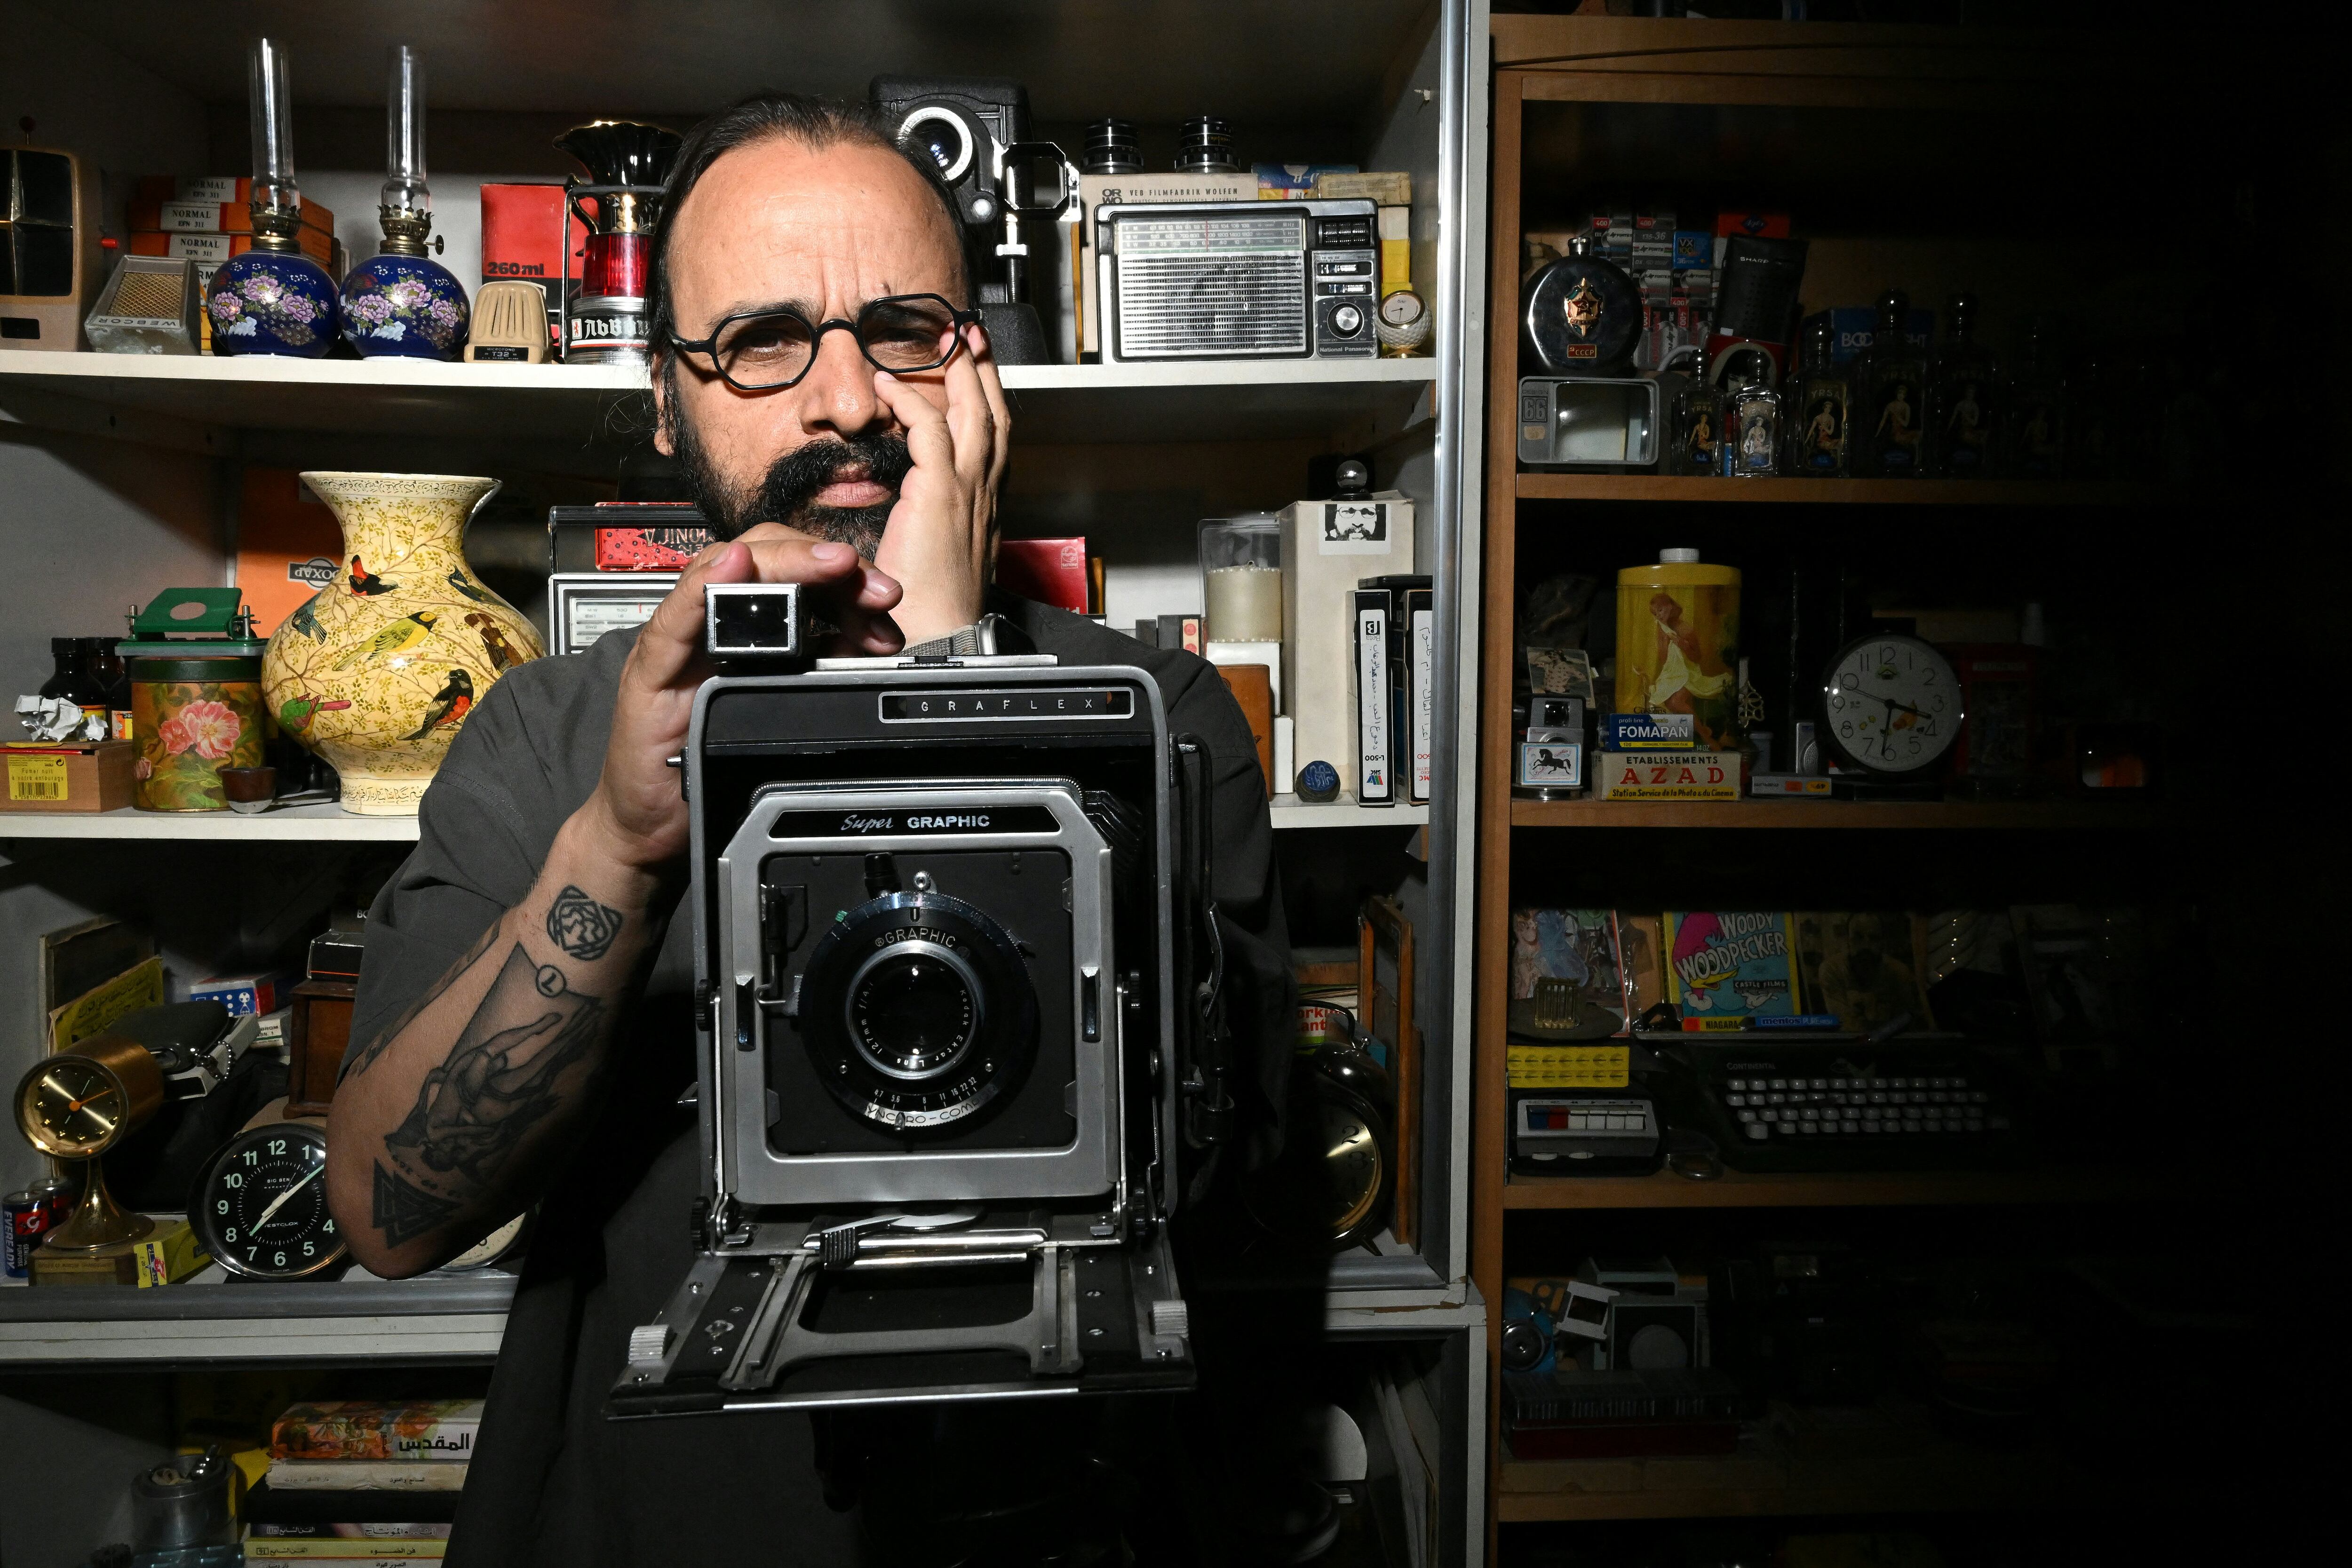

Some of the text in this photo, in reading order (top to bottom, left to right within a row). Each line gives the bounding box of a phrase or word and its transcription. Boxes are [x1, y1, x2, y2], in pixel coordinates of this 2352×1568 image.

[173, 210, 211, 218] NORMAL
[181, 239, 219, 248] NORMAL
[1679, 239, 1693, 247] VX
[1860, 653, 1869, 672] 11
[1880, 646, 1896, 665] 12
[1839, 673, 1859, 691] 10
[1922, 668, 1936, 685] 2
[921, 699, 1094, 712] GRAFLEX
[1832, 696, 1845, 713] 9
[1931, 694, 1945, 712] 3
[1619, 726, 1688, 738] FOMAPAN
[1841, 721, 1853, 739] 8
[1925, 719, 1937, 736] 4
[1863, 737, 1874, 756] 7
[1883, 744, 1896, 762] 6
[1908, 736, 1921, 754] 5
[1620, 767, 1724, 784] AZAD
[841, 814, 990, 833] Super GRAPHIC
[1718, 912, 1774, 940] WOODY
[1676, 931, 1788, 984] WOODPECKER
[960, 989, 969, 1026] Kodak
[1706, 1021, 1739, 1029] NIAGARA
[861, 1019, 882, 1054] 127mm
[935, 1035, 963, 1061] Ektar
[1726, 1062, 1776, 1070] CONTINENTAL
[960, 1082, 969, 1091] 22
[968, 1076, 977, 1086] 32
[874, 1089, 884, 1097] 4.7
[891, 1094, 900, 1103] 5.6
[951, 1088, 959, 1096] 16
[1342, 1126, 1360, 1144] 2
[268, 1140, 286, 1155] 12
[302, 1145, 310, 1160] 1
[243, 1151, 257, 1165] 11
[1348, 1151, 1368, 1170] 3
[223, 1173, 242, 1188] 10
[217, 1200, 229, 1215] 9
[226, 1227, 237, 1242] 8
[323, 1219, 335, 1234] 4
[4, 1210, 15, 1269] EVEREADY
[247, 1247, 257, 1261] 7
[303, 1242, 315, 1256] 5
[274, 1251, 286, 1266] 6
[399, 1433, 469, 1451] المقدس
